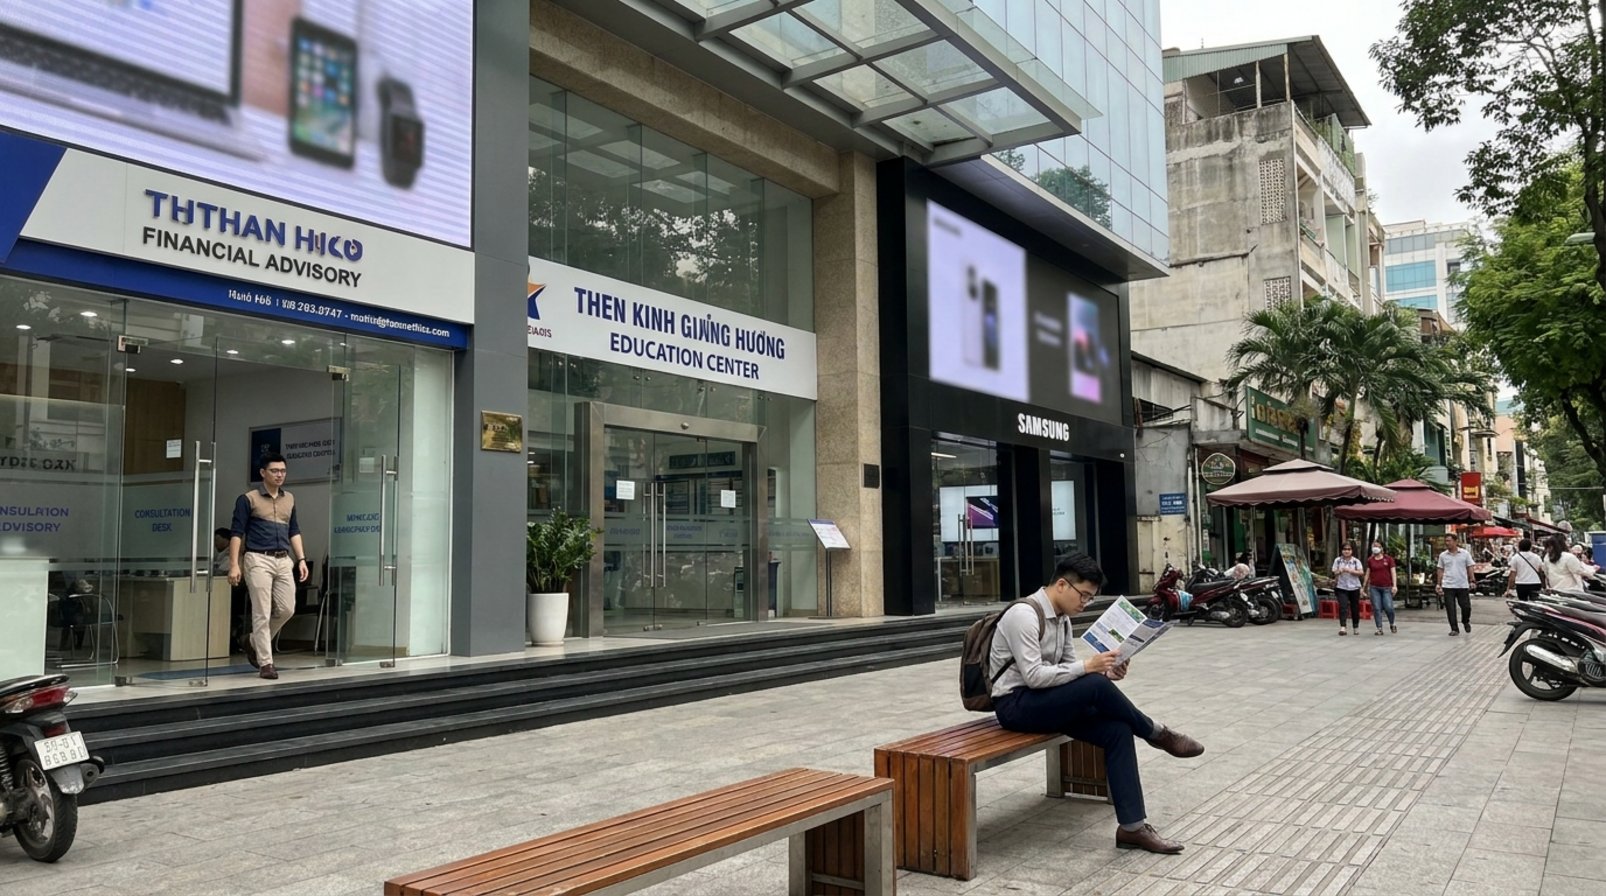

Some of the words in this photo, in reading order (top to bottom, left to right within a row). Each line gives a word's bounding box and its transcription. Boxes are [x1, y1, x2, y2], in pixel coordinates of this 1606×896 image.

[142, 227, 260, 267] FINANCIAL
[264, 254, 363, 288] ADVISORY
[574, 287, 626, 323] THEN
[632, 304, 675, 334] KINH
[610, 332, 703, 369] EDUCATION
[707, 354, 760, 380] CENTER
[1018, 413, 1069, 441] SAMSUNG
[134, 508, 191, 519] CONSULTATION
